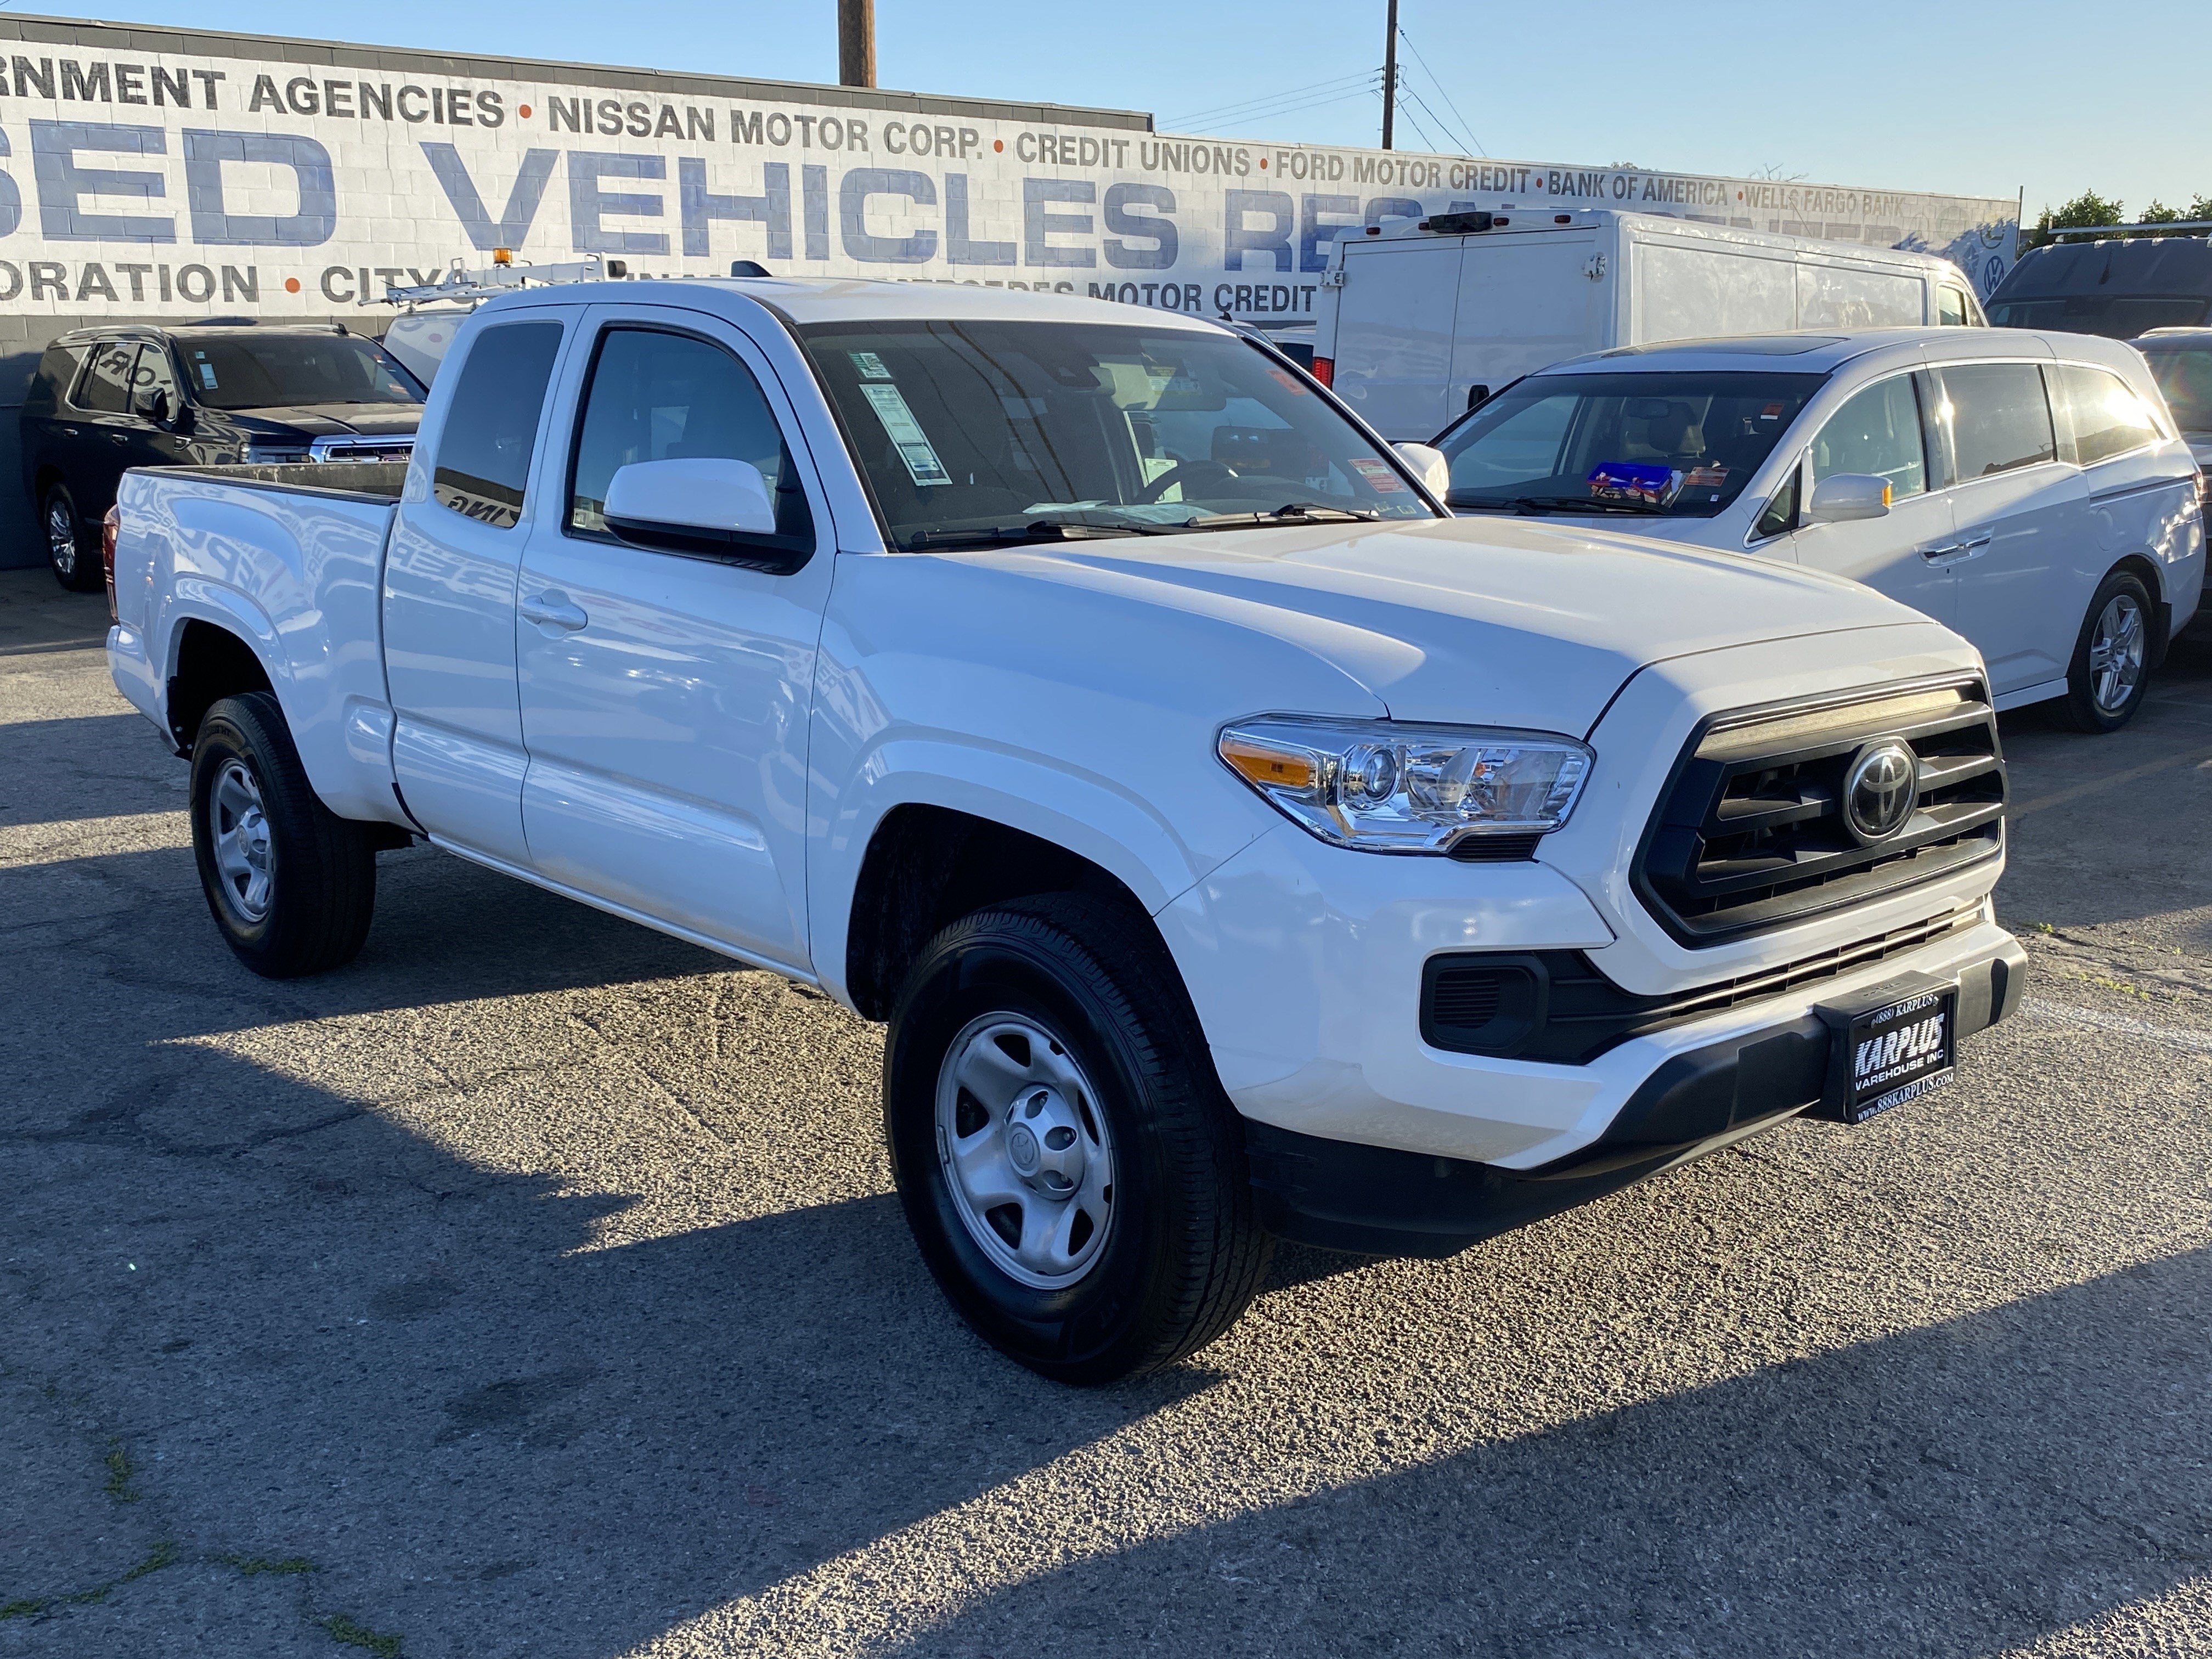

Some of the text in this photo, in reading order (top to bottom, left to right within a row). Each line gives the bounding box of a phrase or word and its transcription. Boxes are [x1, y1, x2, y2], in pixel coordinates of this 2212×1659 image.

[0, 56, 1905, 216] NMENT AGENCIES NISSAN MOTOR CORP. CREDIT UNIONS FORD MOTOR CREDIT BANK OF AMERICA WELLS FARGO BANK
[0, 119, 337, 247] ED
[419, 142, 1178, 269] VEHICLES
[1089, 283, 1201, 312] MOTOR
[1214, 284, 1317, 312] CREDIT
[1895, 994, 1934, 1018] KARPLUS
[1855, 1013, 1944, 1077] KARPLUS
[1927, 1049, 1944, 1064] INC
